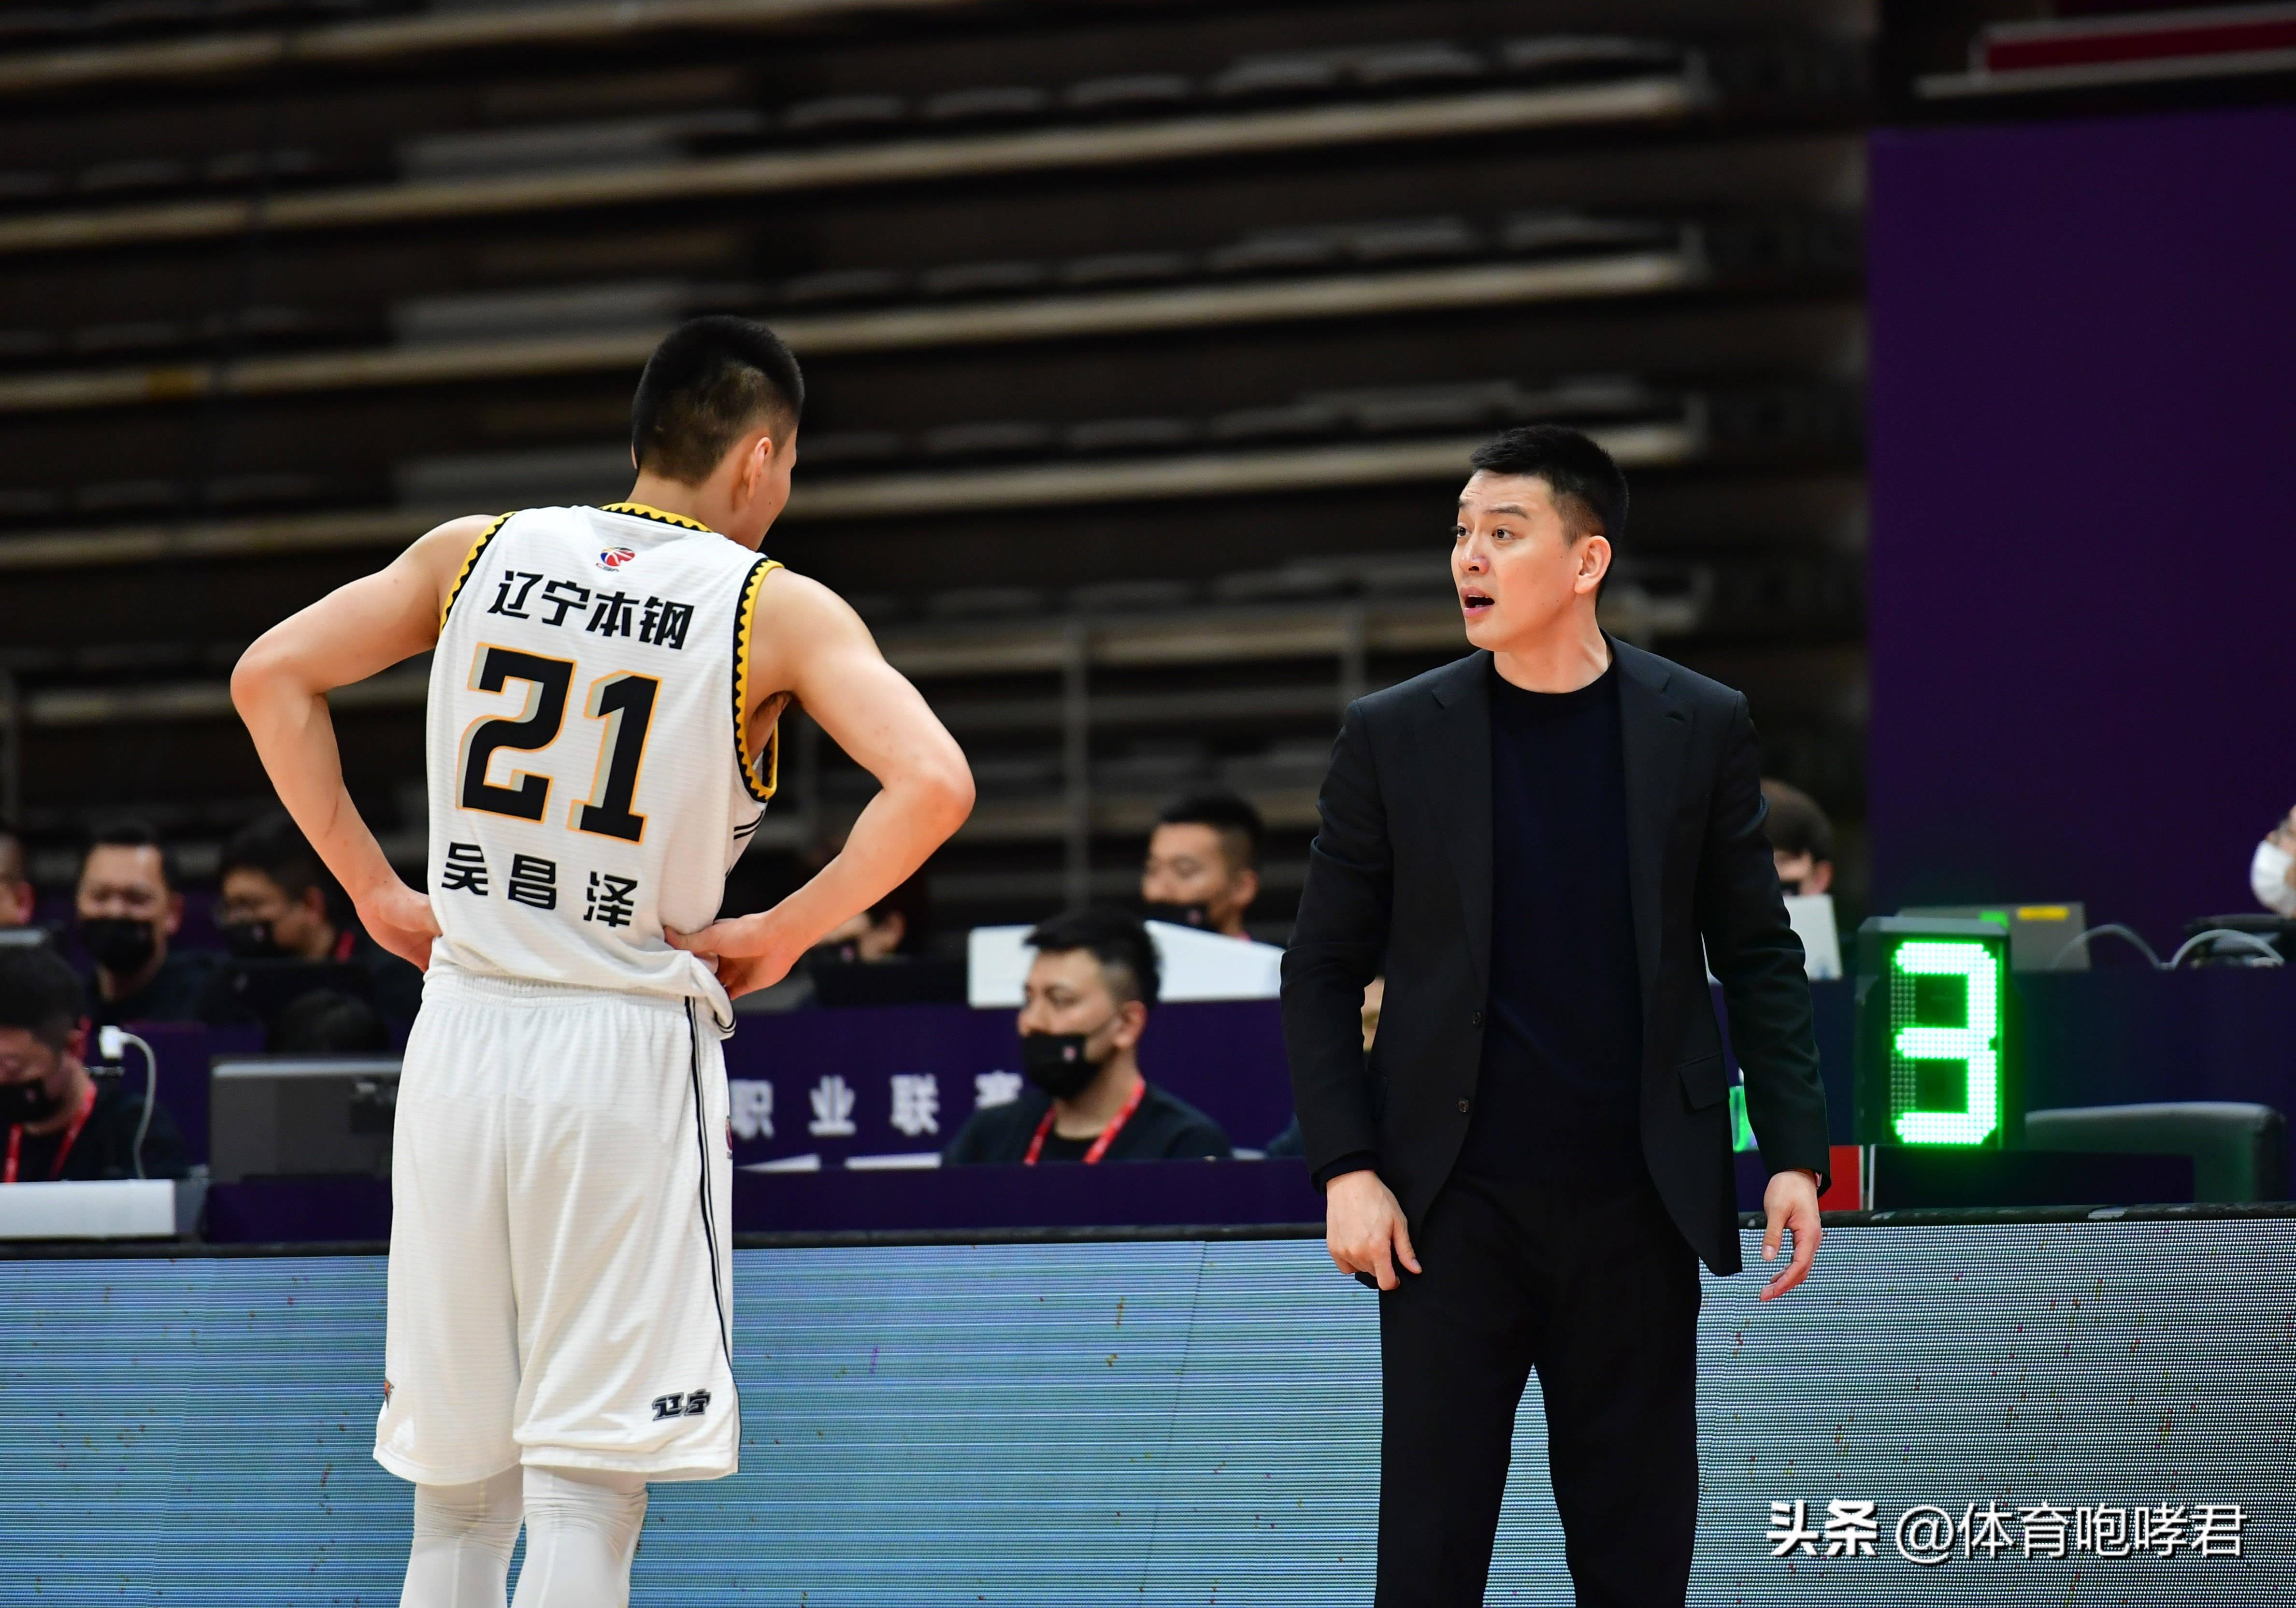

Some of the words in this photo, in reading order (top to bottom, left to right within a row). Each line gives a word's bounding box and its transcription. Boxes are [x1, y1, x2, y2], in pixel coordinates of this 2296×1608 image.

[487, 570, 695, 650] 辽宁本钢
[456, 642, 662, 845] 21
[442, 842, 638, 927] 吴昌泽
[1894, 941, 1997, 1145] 3
